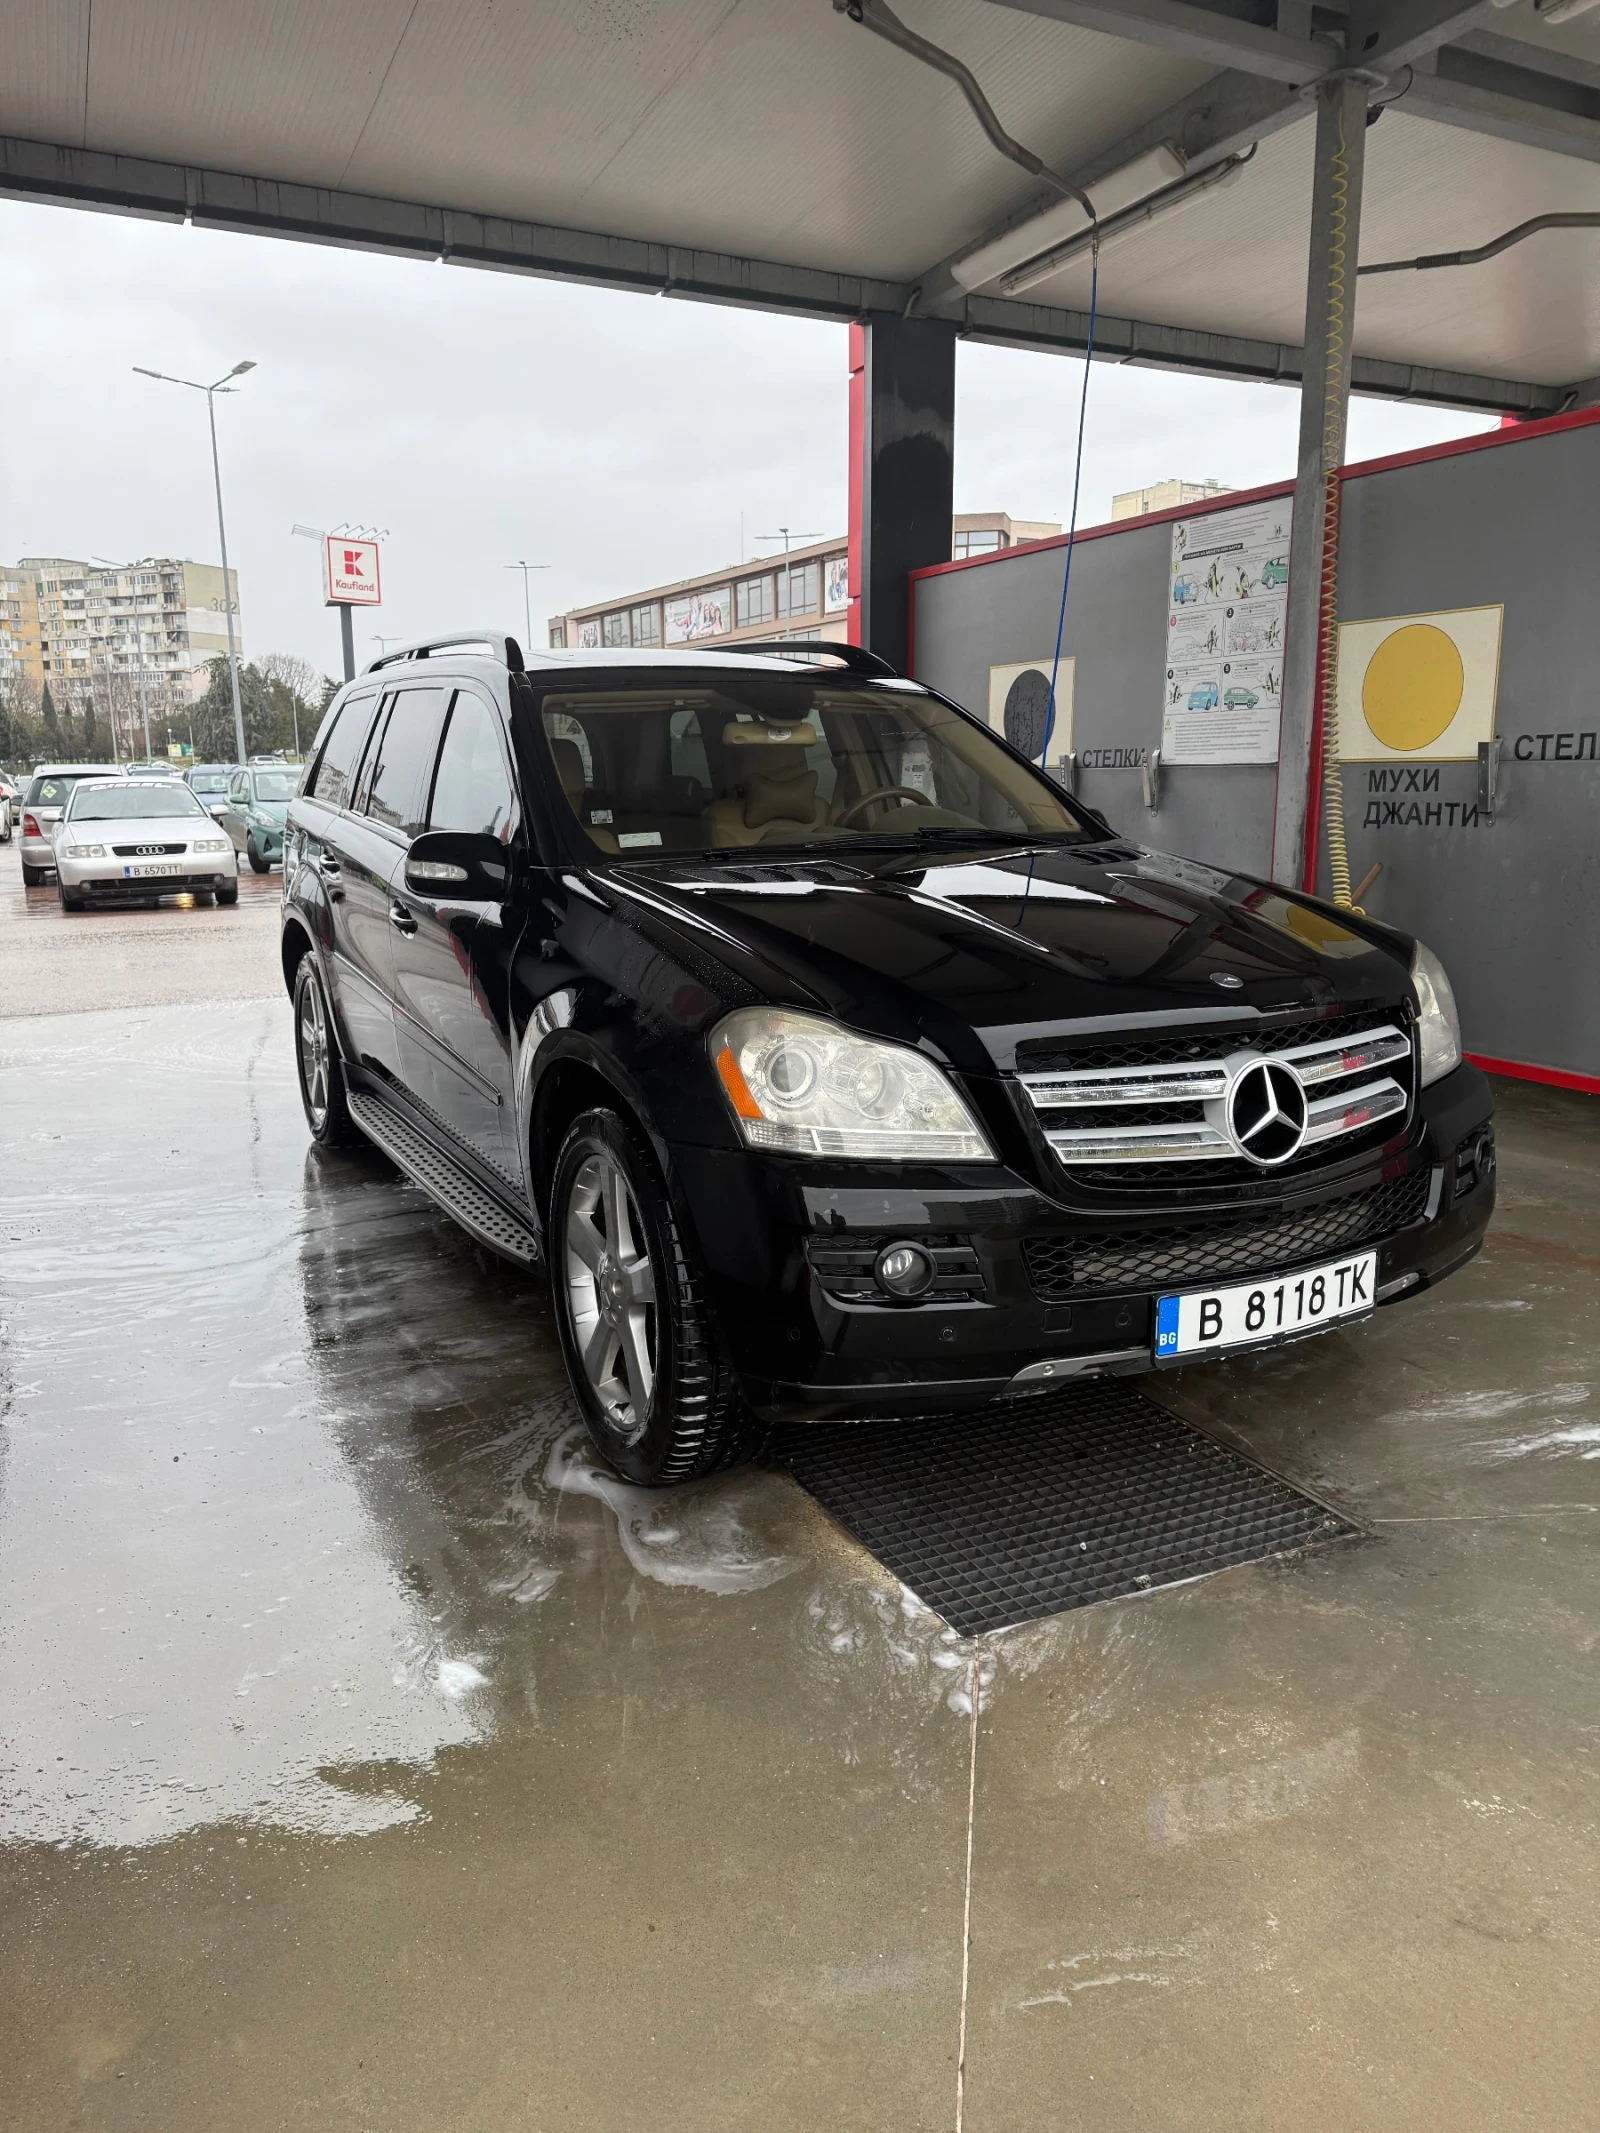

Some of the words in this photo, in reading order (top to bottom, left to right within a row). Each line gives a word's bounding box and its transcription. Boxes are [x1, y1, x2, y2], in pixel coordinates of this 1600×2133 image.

[335, 578, 375, 592] Kaufland
[210, 597, 238, 614] 302
[1514, 732, 1600, 761] СТЕЛ
[1082, 748, 1146, 768] СТЕЛКИ
[1368, 768, 1440, 793] МУХИ
[1363, 800, 1479, 829] ДЖАНТИ
[134, 867, 141, 876] B
[144, 866, 167, 876] 6570
[168, 865, 178, 874] TT
[1198, 1297, 1223, 1342] B
[1245, 1274, 1326, 1332] 8118
[1334, 1259, 1370, 1308] TK
[1159, 1332, 1177, 1347] BG
